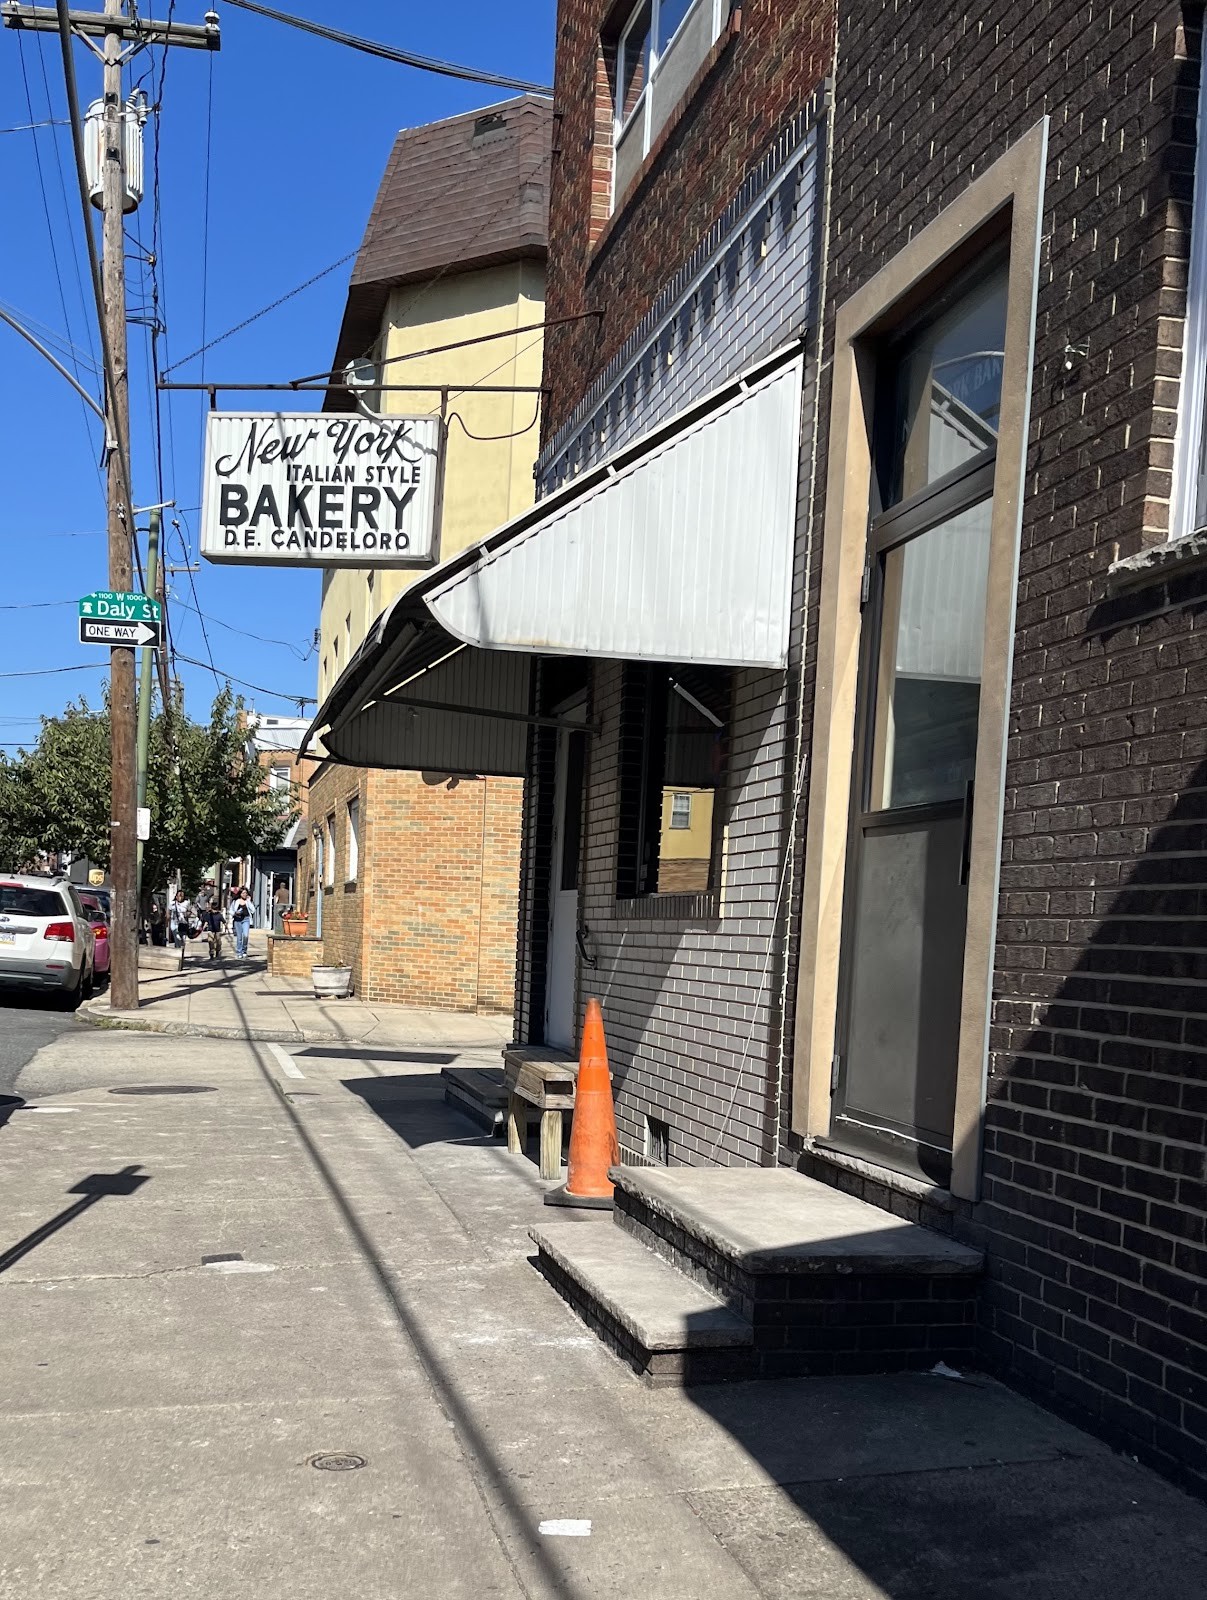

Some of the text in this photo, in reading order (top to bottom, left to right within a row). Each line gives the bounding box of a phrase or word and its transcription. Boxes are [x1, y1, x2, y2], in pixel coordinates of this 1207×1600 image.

[215, 421, 422, 476] New York
[286, 465, 421, 484] ITALIAN STYLE
[219, 484, 418, 530] BAKERY
[271, 530, 410, 550] CANDELORO
[116, 593, 125, 601] W
[97, 600, 159, 620] Daly St
[88, 626, 136, 637] ONE WAY
